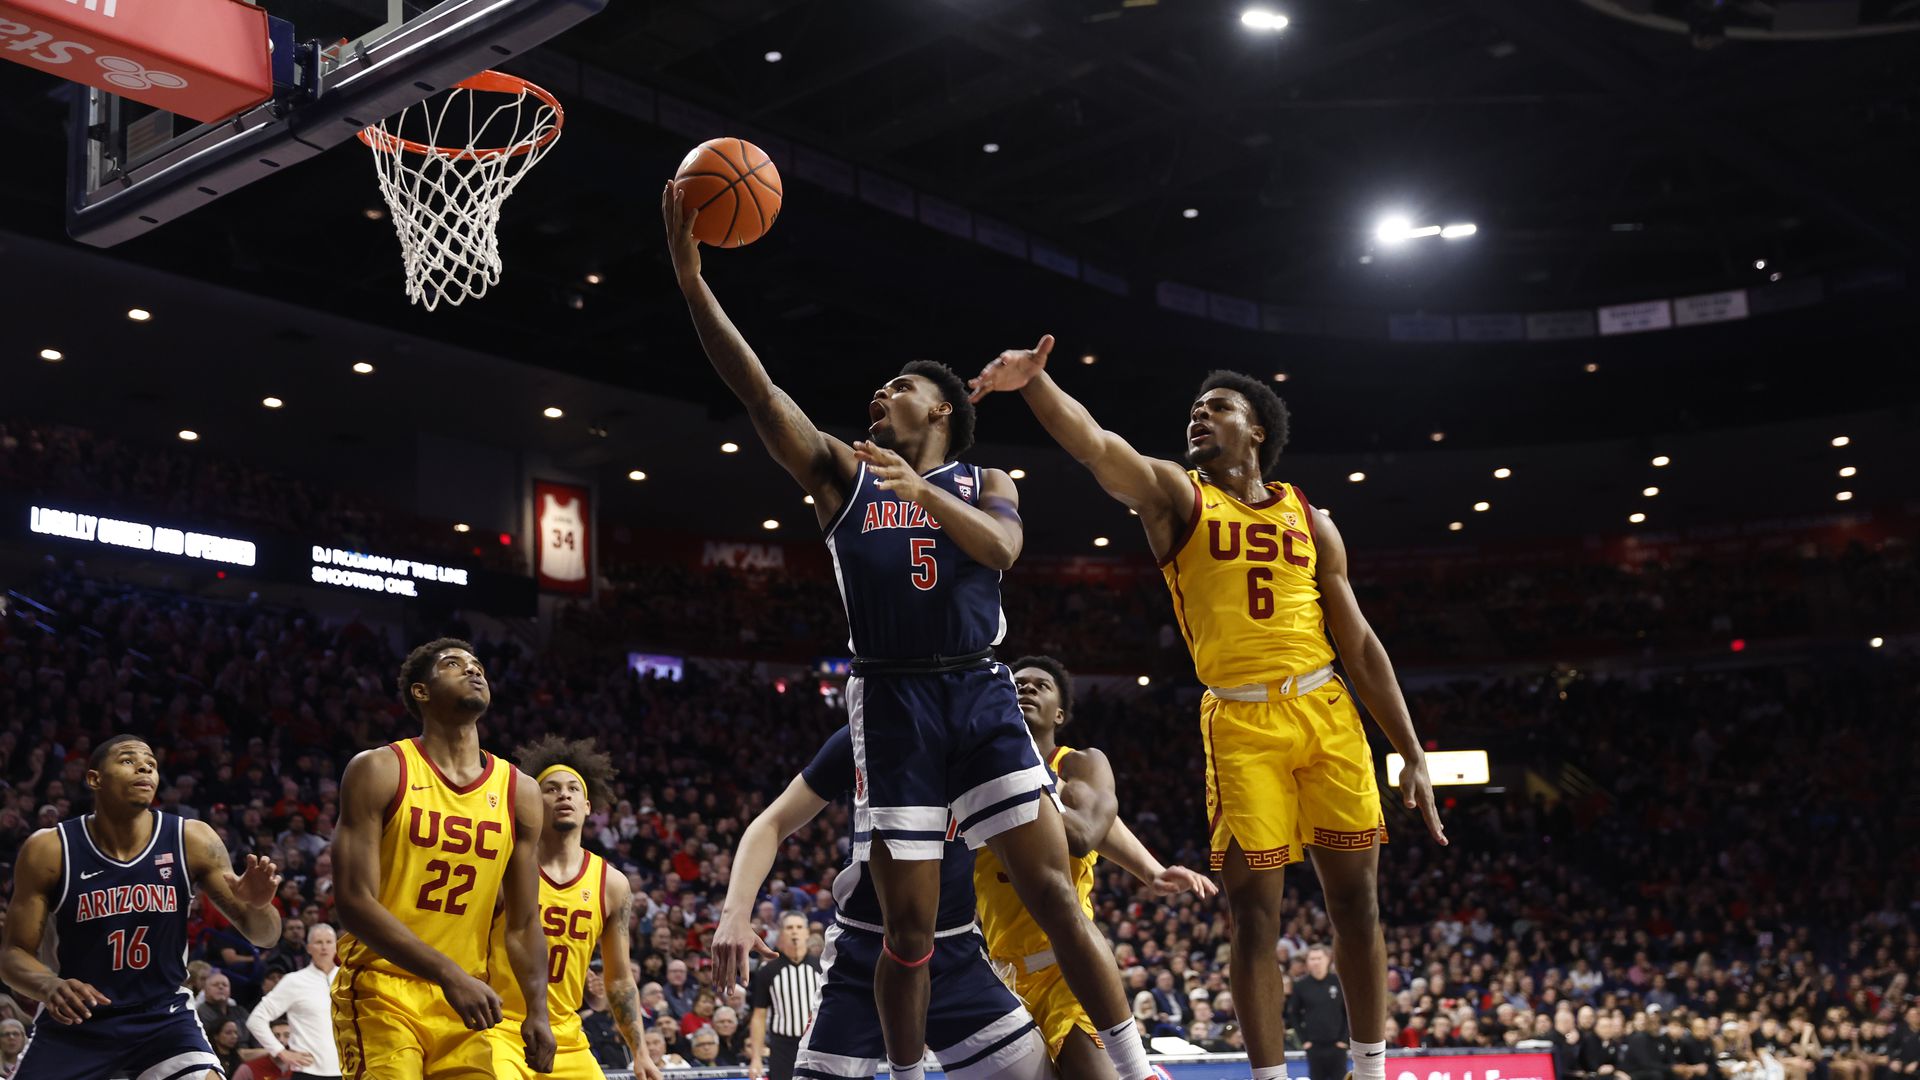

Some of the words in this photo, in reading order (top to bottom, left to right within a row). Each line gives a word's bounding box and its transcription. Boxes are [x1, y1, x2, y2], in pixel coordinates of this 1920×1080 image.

[312, 545, 331, 563] DJ
[552, 529, 574, 551] 34
[1207, 520, 1311, 568] USC
[910, 538, 938, 591] 5
[1247, 567, 1275, 620] 6
[409, 806, 502, 861] USC
[76, 884, 177, 922] ARIZONA
[416, 859, 477, 915] 22
[538, 904, 592, 940] SC
[107, 926, 151, 971] 16
